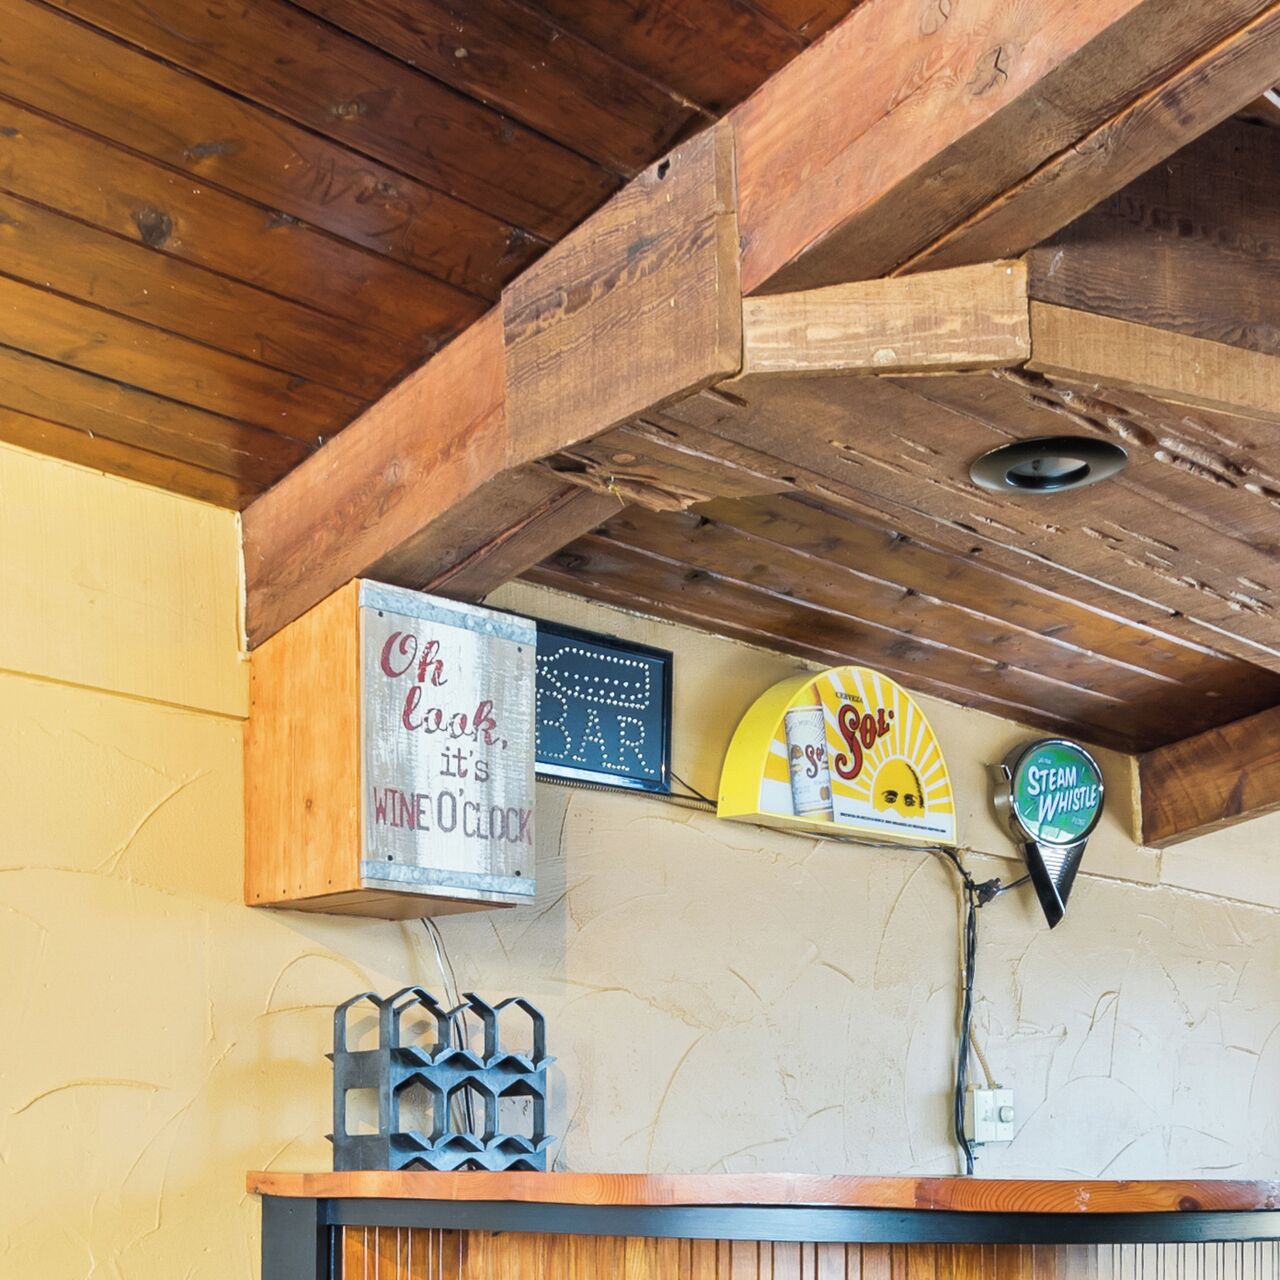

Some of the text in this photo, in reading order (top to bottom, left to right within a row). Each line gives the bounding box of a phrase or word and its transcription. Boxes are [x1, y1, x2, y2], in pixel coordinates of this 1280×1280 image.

[380, 631, 448, 687] Oh
[536, 688, 655, 773] BAR
[439, 746, 491, 782] it's
[1027, 765, 1077, 796] STEAM
[373, 786, 533, 846] WINE O'CLOCK
[1038, 784, 1097, 825] WHISTLE
